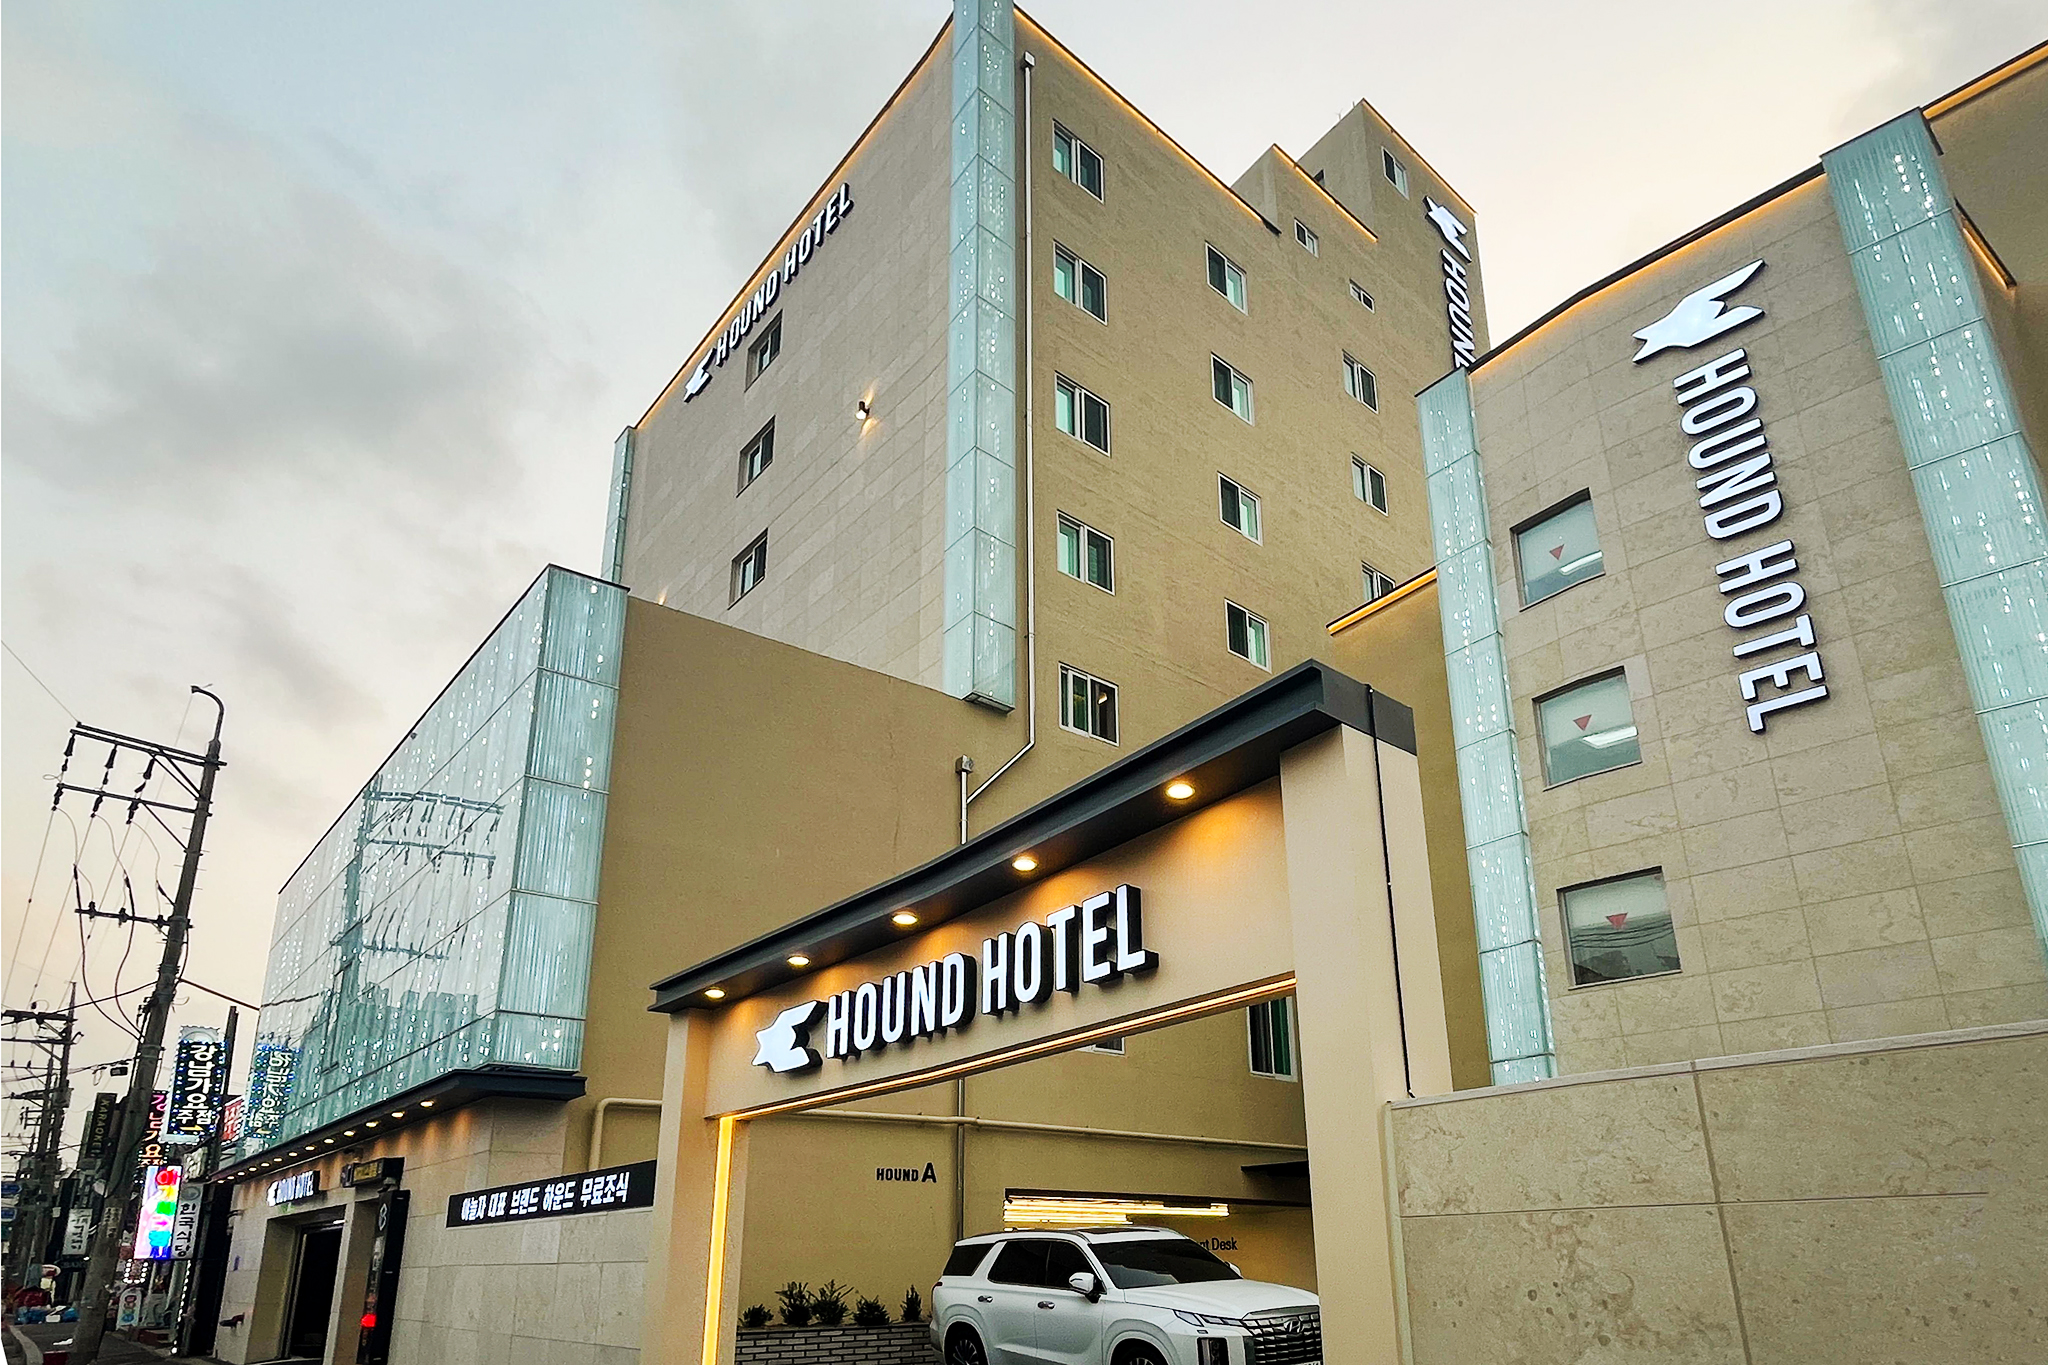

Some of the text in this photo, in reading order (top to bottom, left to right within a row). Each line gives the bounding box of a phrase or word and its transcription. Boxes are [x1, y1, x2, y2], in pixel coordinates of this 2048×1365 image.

[715, 182, 854, 367] HOUND HOTEL
[1672, 347, 1829, 734] HOUND HOTEL
[825, 884, 1154, 1059] HOUND HOTEL
[182, 1044, 219, 1109] 강남가요
[176, 1109, 213, 1125] 주점
[509, 1187, 540, 1214] 브랜드
[543, 1181, 576, 1211] 하운드
[580, 1172, 630, 1207] 무료조식
[876, 1162, 937, 1183] HOUND A
[175, 1203, 196, 1257] 한국식당
[1211, 1237, 1238, 1250] Desk
